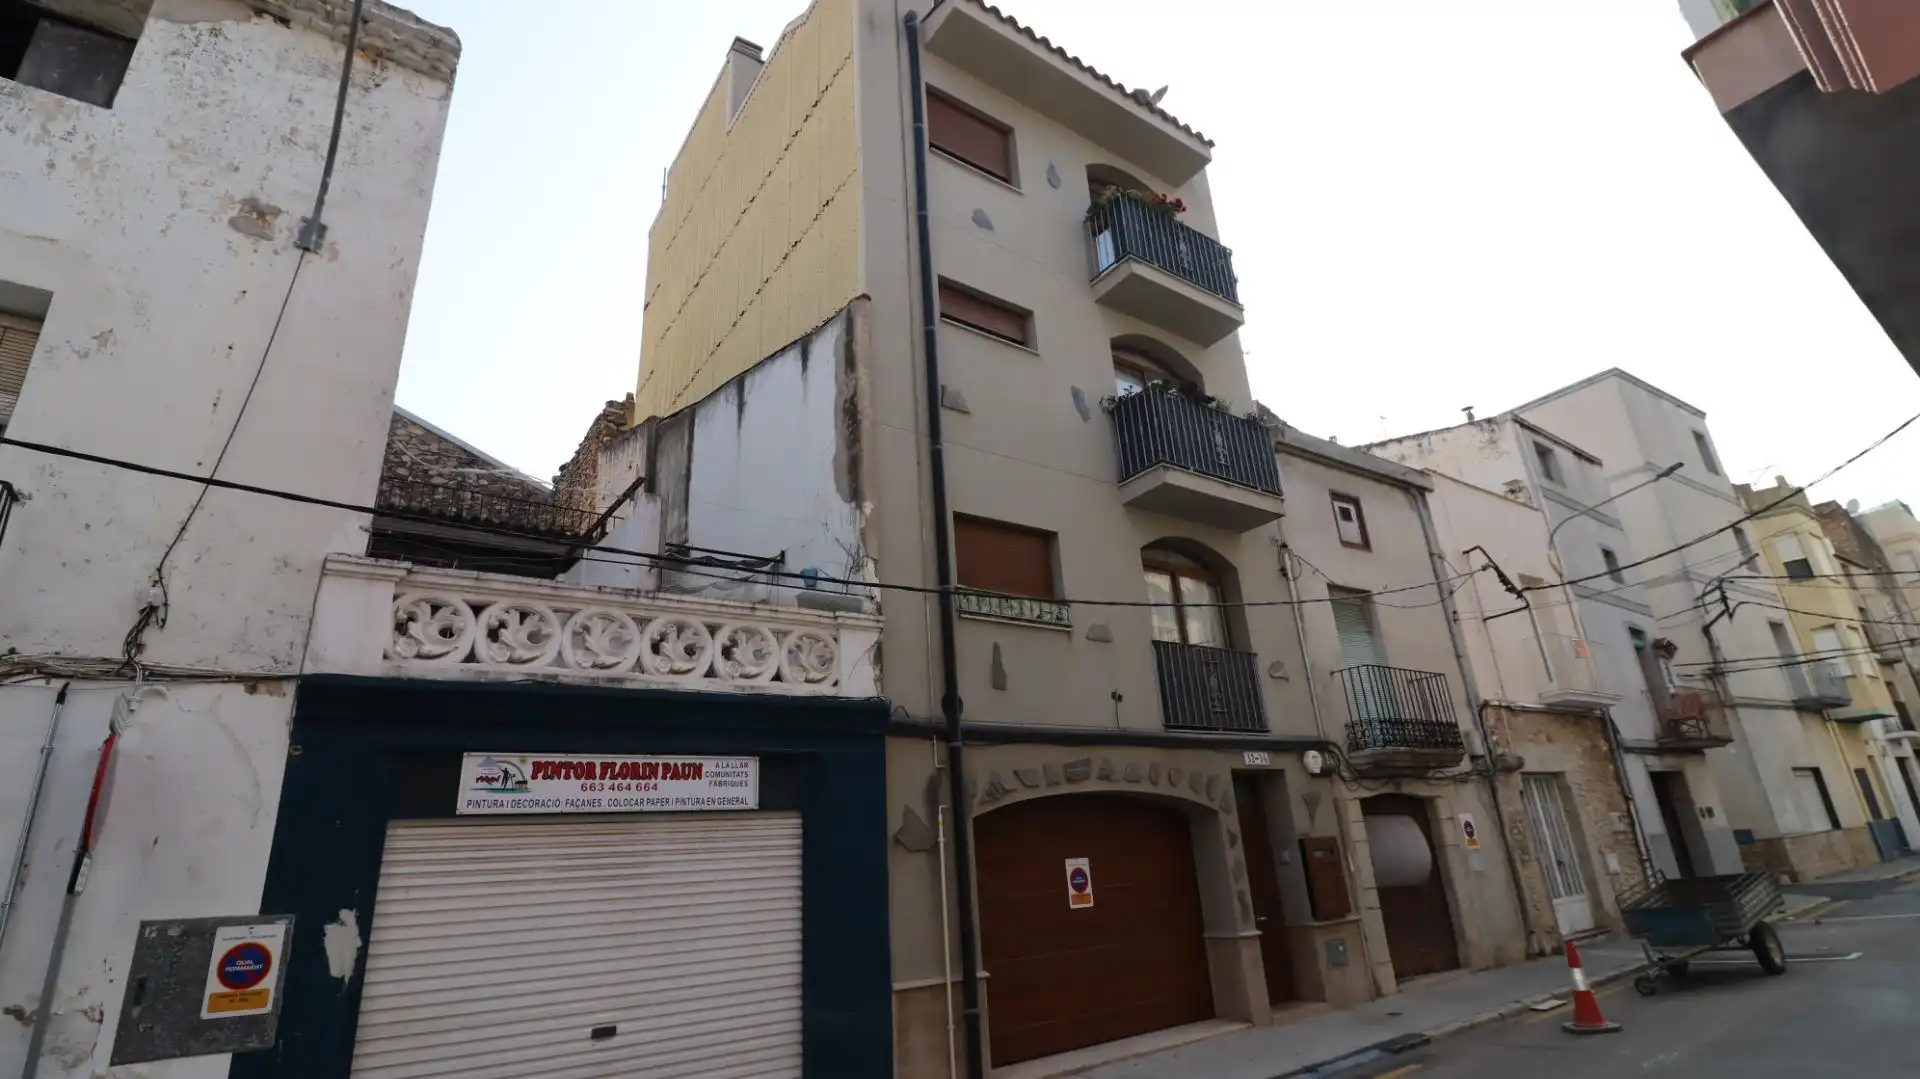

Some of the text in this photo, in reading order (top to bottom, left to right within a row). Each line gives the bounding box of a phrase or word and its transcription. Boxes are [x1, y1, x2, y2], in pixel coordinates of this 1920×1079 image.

[531, 761, 703, 780] PINTOR FLORIN PAUN
[581, 782, 658, 792] 663 464 664
[466, 799, 504, 809] PINTURA
[607, 798, 644, 807] COLOCAR
[646, 798, 670, 807] PAPER
[675, 797, 706, 806] PINTURA
[706, 797, 716, 806] EN
[717, 797, 748, 806] GENERAL
